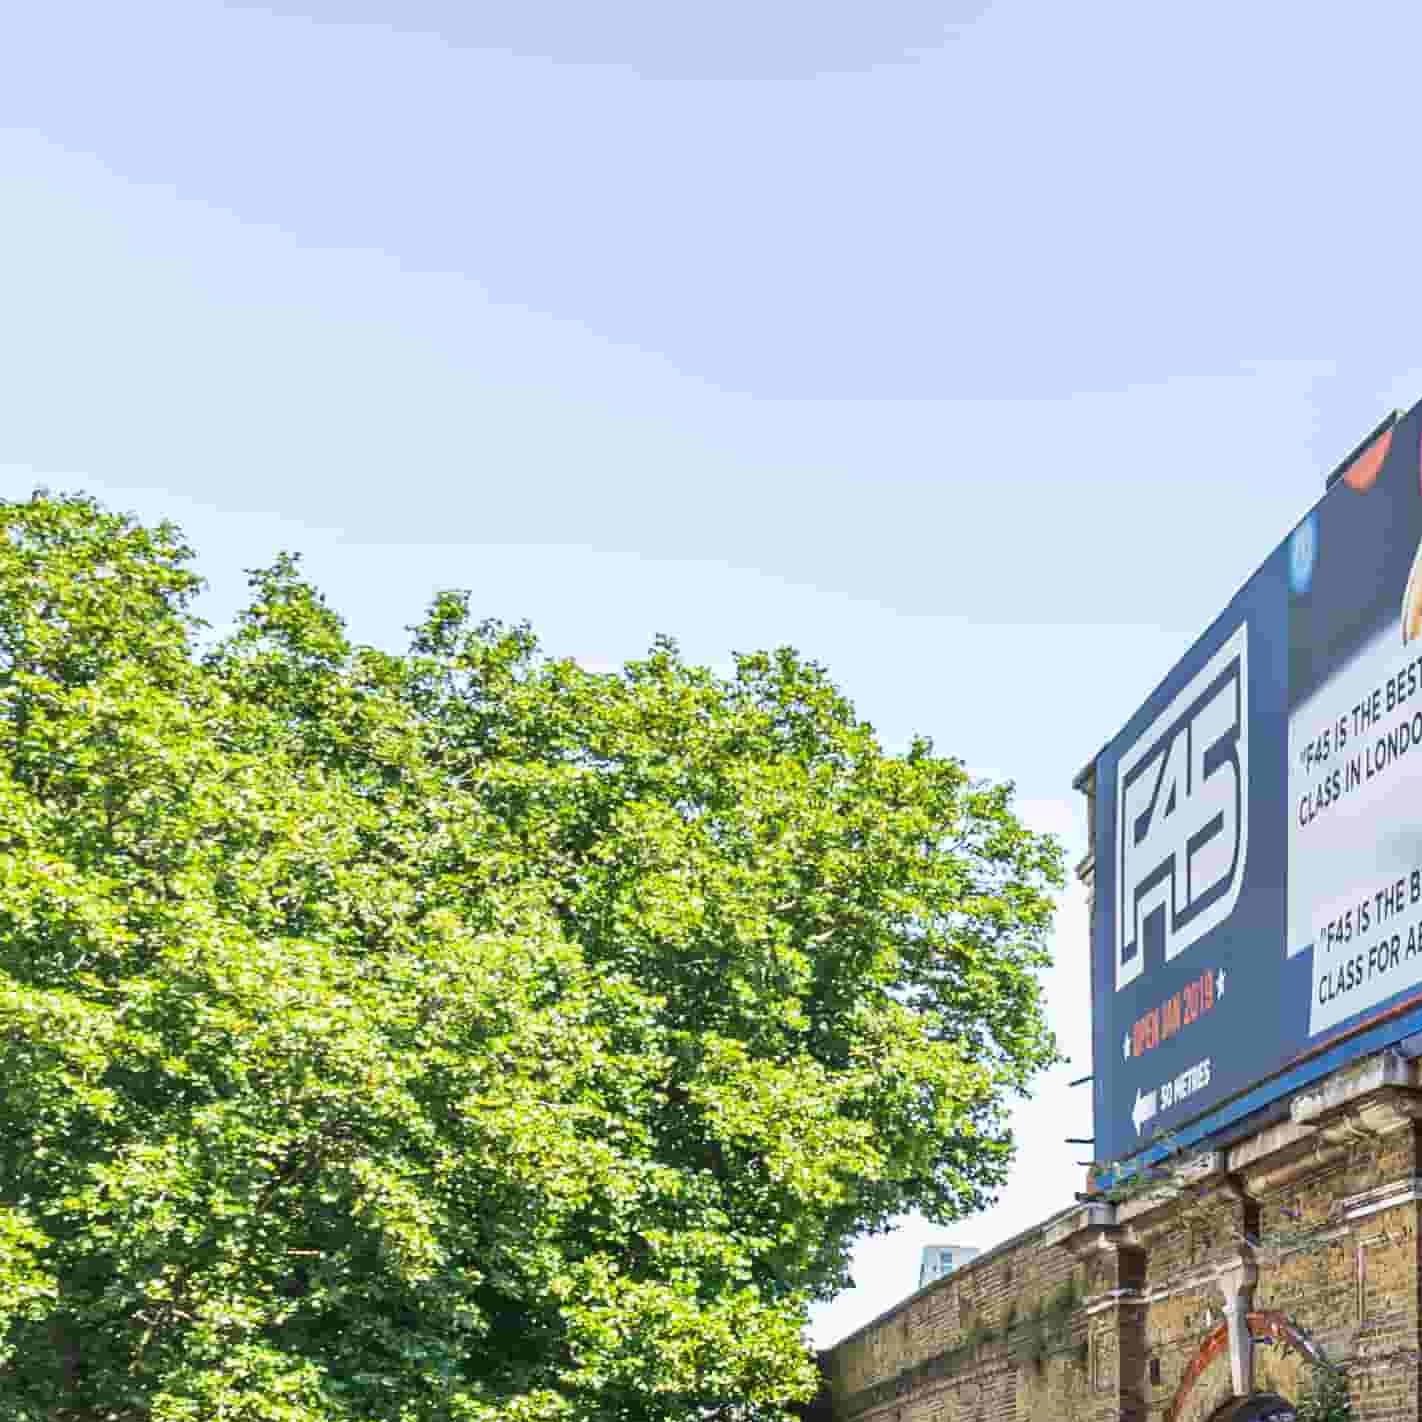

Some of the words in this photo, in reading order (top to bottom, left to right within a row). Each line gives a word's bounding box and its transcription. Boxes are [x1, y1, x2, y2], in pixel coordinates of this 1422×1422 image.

[1334, 716, 1347, 750] IS
[1352, 689, 1381, 744] THE
[1118, 640, 1243, 978] F45
[1299, 770, 1340, 826] CLASS
[1345, 760, 1361, 792] IN
[1356, 900, 1370, 936] IS
[1375, 879, 1405, 924] THE
[1184, 971, 1214, 1024] 2019
[1319, 954, 1362, 1005] CLASS
[1368, 935, 1400, 979] FOR
